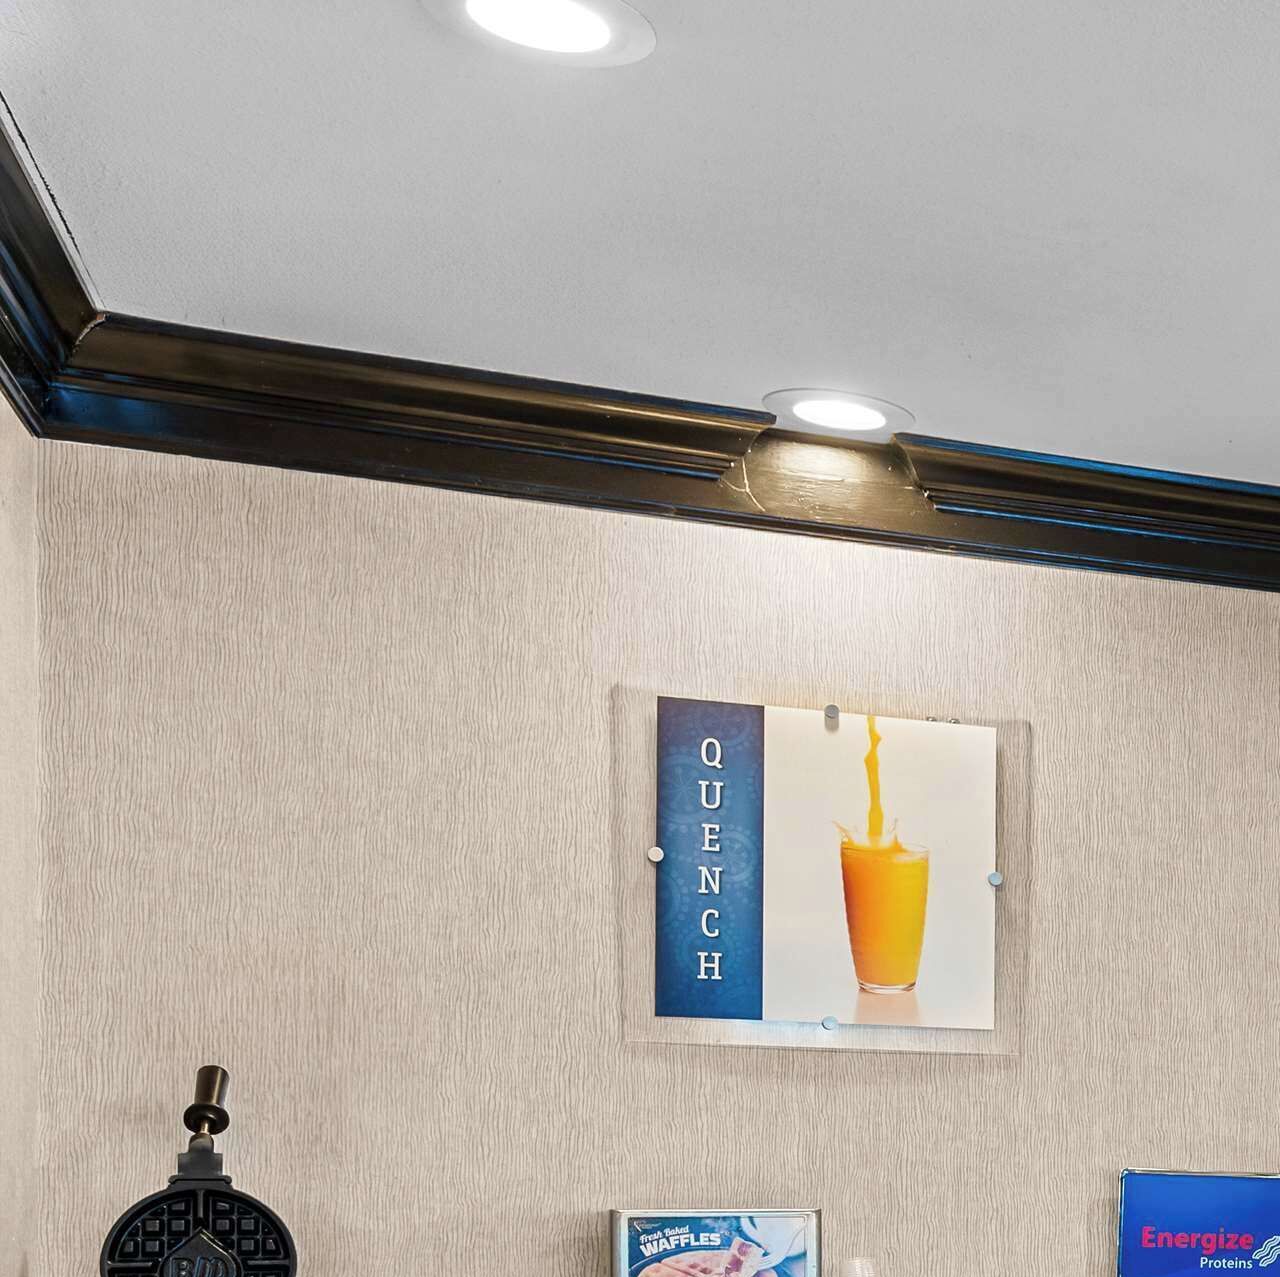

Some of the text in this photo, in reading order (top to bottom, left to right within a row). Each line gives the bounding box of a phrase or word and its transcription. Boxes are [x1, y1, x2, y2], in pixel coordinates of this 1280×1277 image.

[696, 737, 724, 981] QUENCH
[639, 1232, 721, 1258] WAFFLES
[1141, 1225, 1254, 1255] Energize
[1200, 1257, 1253, 1270] Proteins
